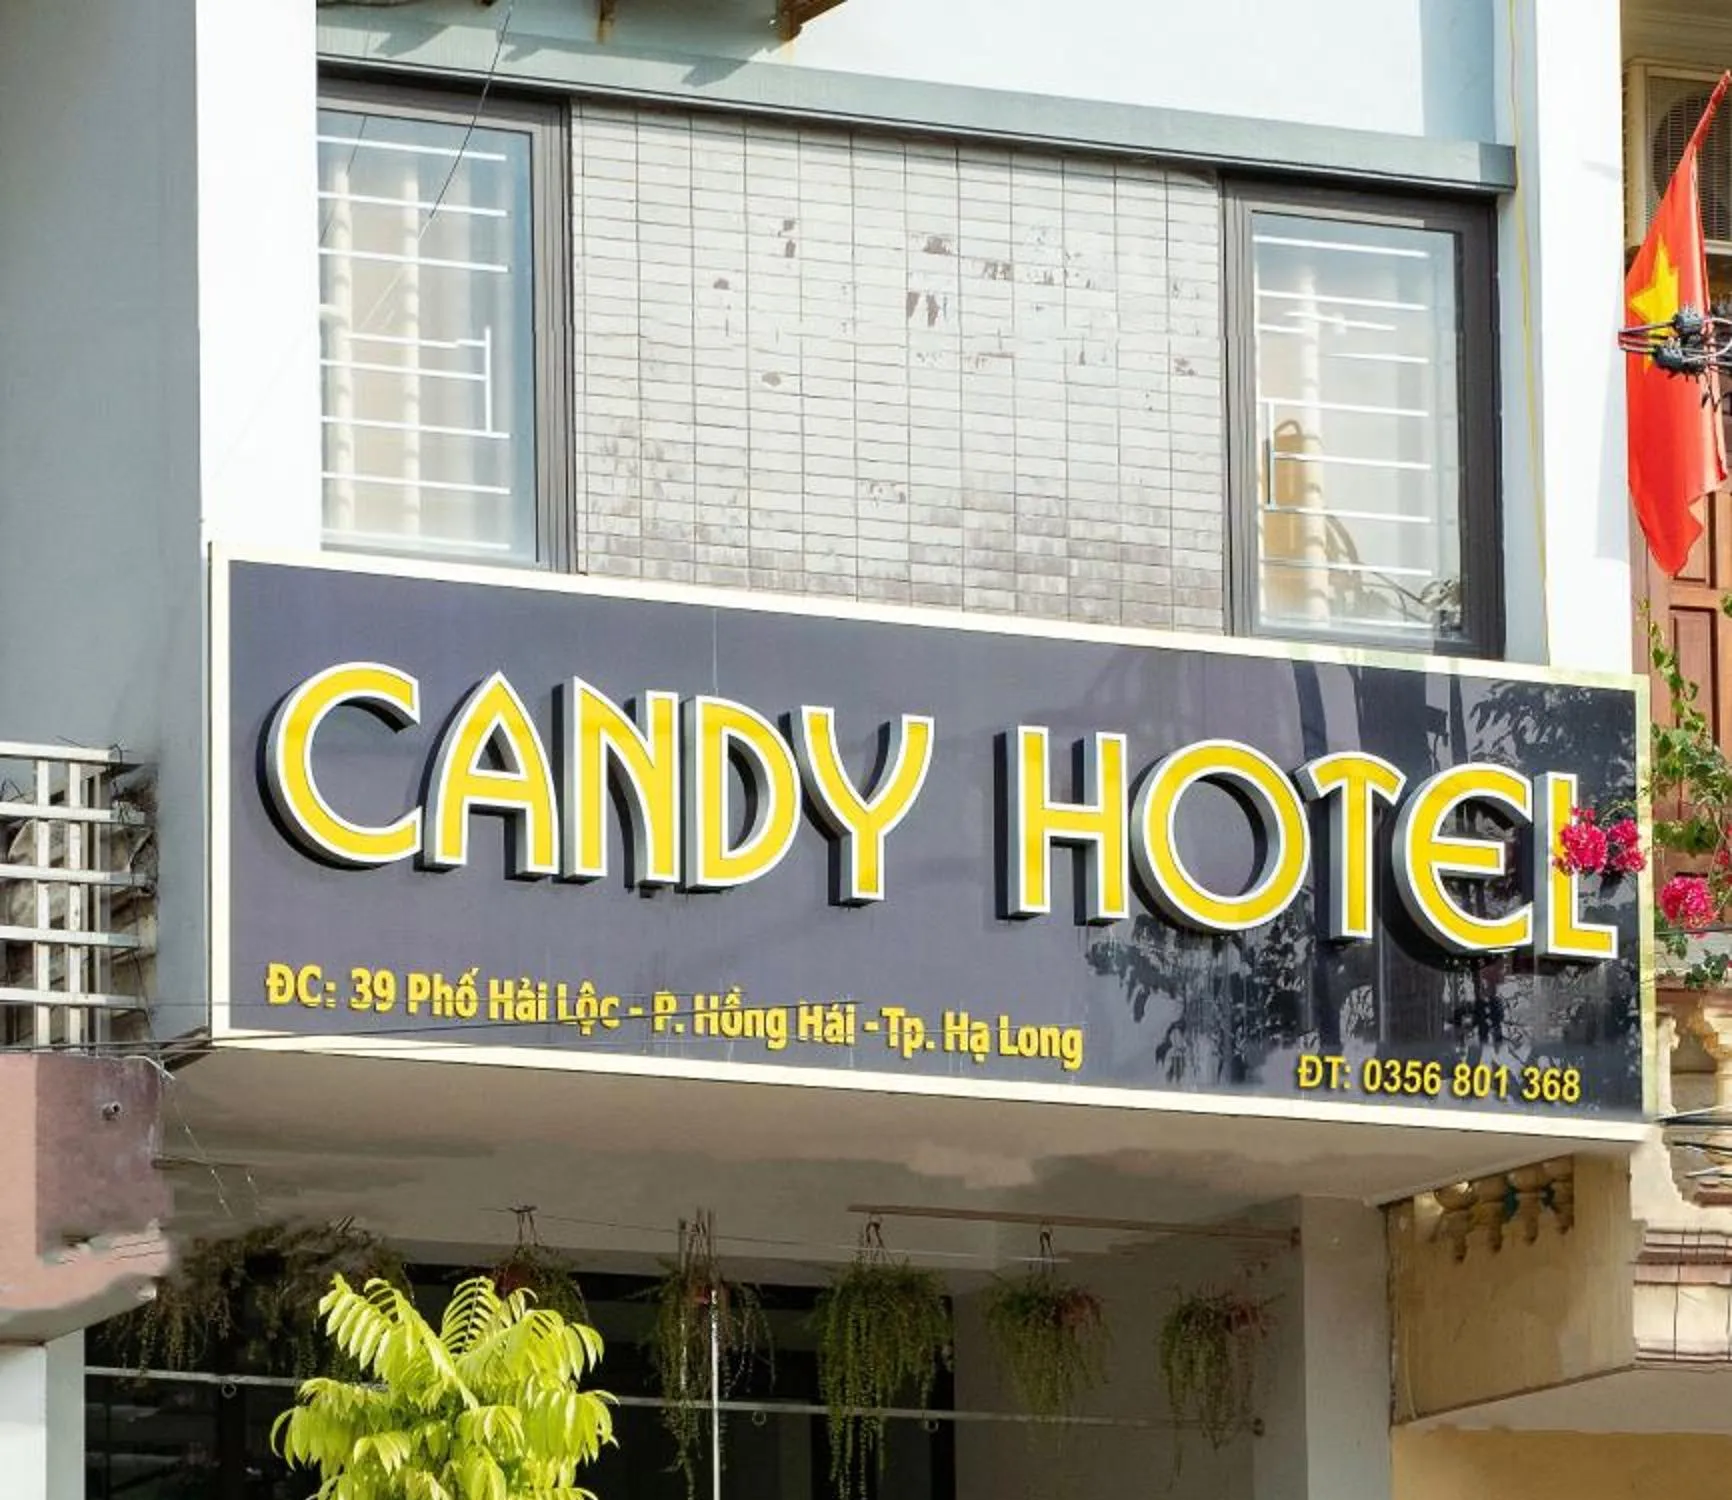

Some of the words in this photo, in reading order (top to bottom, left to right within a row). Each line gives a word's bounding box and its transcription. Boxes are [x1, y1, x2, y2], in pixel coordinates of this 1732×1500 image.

[266, 660, 935, 902] CANDY
[1010, 725, 1619, 960] HOTEL
[266, 962, 336, 1008] ĐC:
[351, 967, 397, 1012] 39
[407, 967, 479, 1018] Phố
[488, 977, 548, 1022] Hải
[557, 979, 621, 1036] Lộc
[654, 991, 685, 1033] P.
[943, 1010, 990, 1063] Hạ
[998, 1015, 1083, 1070] Long
[1298, 1055, 1351, 1089] ĐT:
[1362, 1059, 1442, 1096] 0356
[1453, 1063, 1508, 1099] 801
[1522, 1066, 1582, 1103] 368
